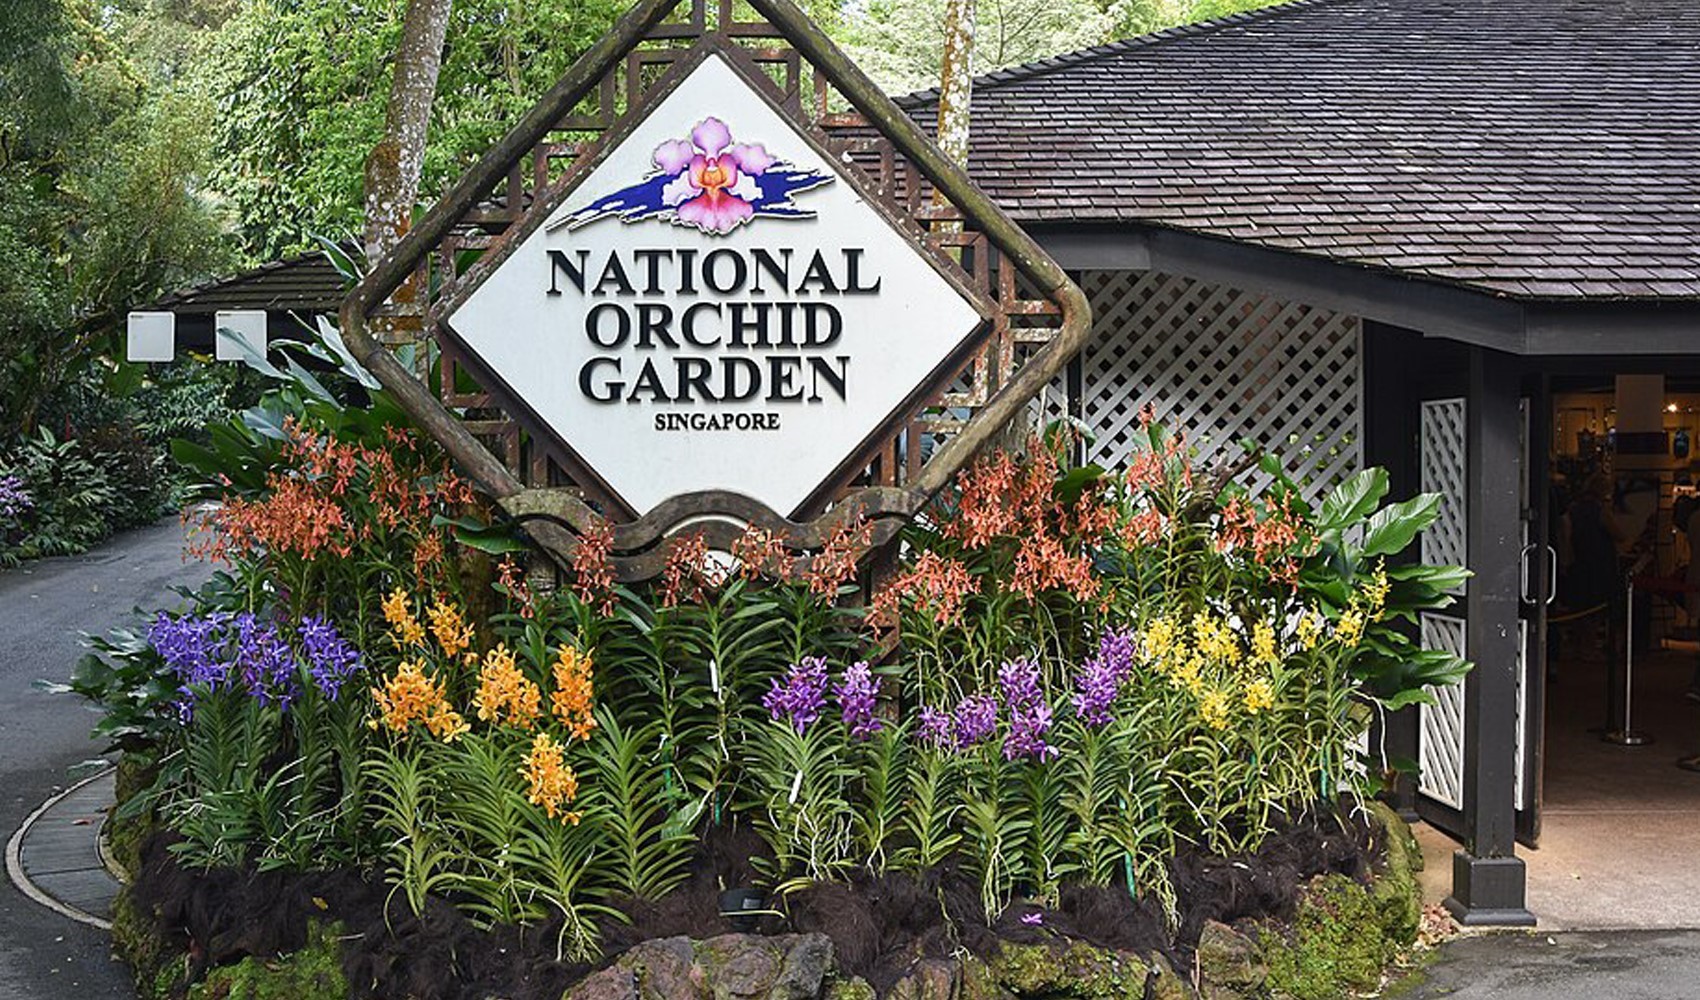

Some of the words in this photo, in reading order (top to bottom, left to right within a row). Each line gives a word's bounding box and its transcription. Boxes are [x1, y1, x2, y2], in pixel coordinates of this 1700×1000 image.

[546, 249, 881, 296] NATIONAL
[585, 302, 843, 350] ORCHID
[578, 355, 850, 404] GARDEN
[654, 413, 781, 431] SINGAPORE
